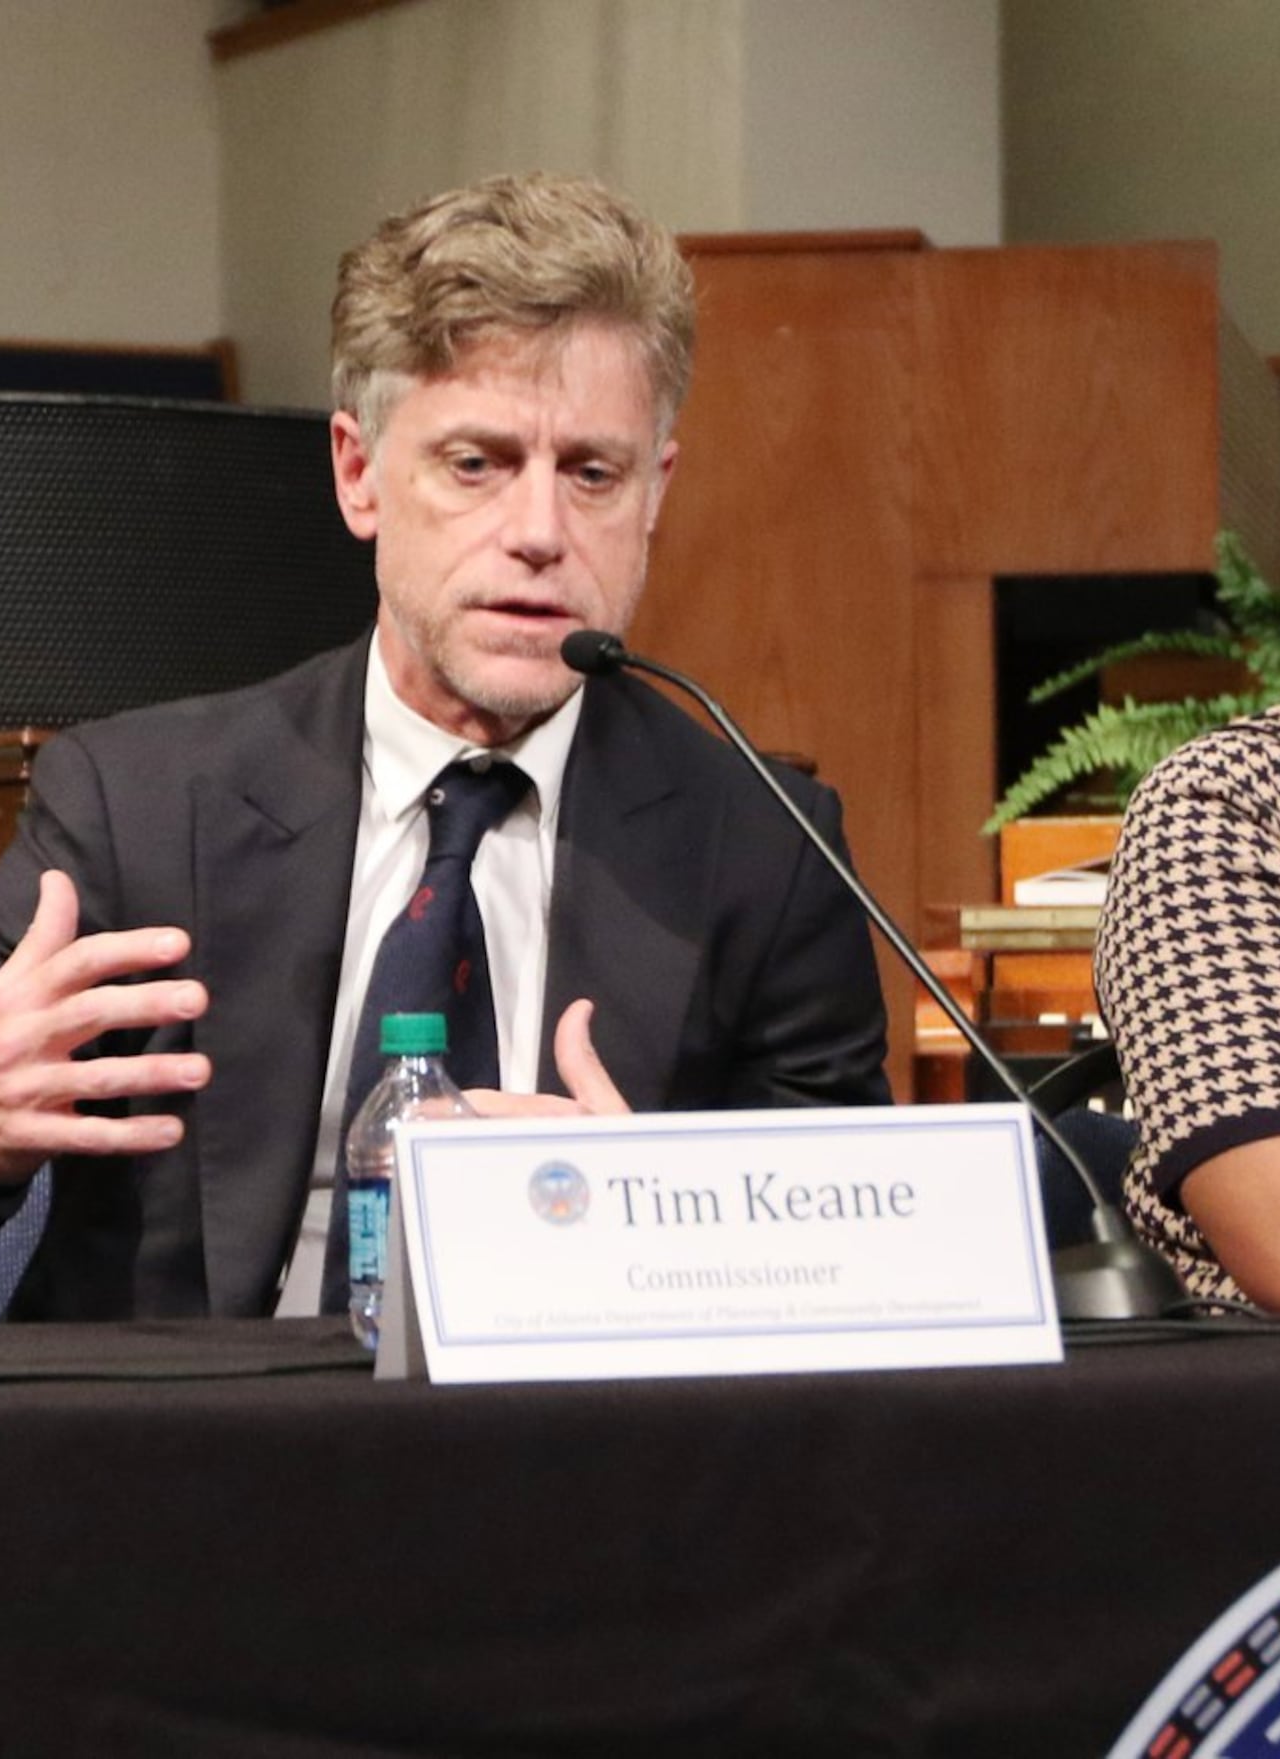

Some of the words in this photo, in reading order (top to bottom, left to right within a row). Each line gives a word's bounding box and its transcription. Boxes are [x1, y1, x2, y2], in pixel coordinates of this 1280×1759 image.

[608, 1176, 722, 1226] Tim
[742, 1172, 916, 1222] Keane
[626, 1260, 842, 1292] Commissioner
